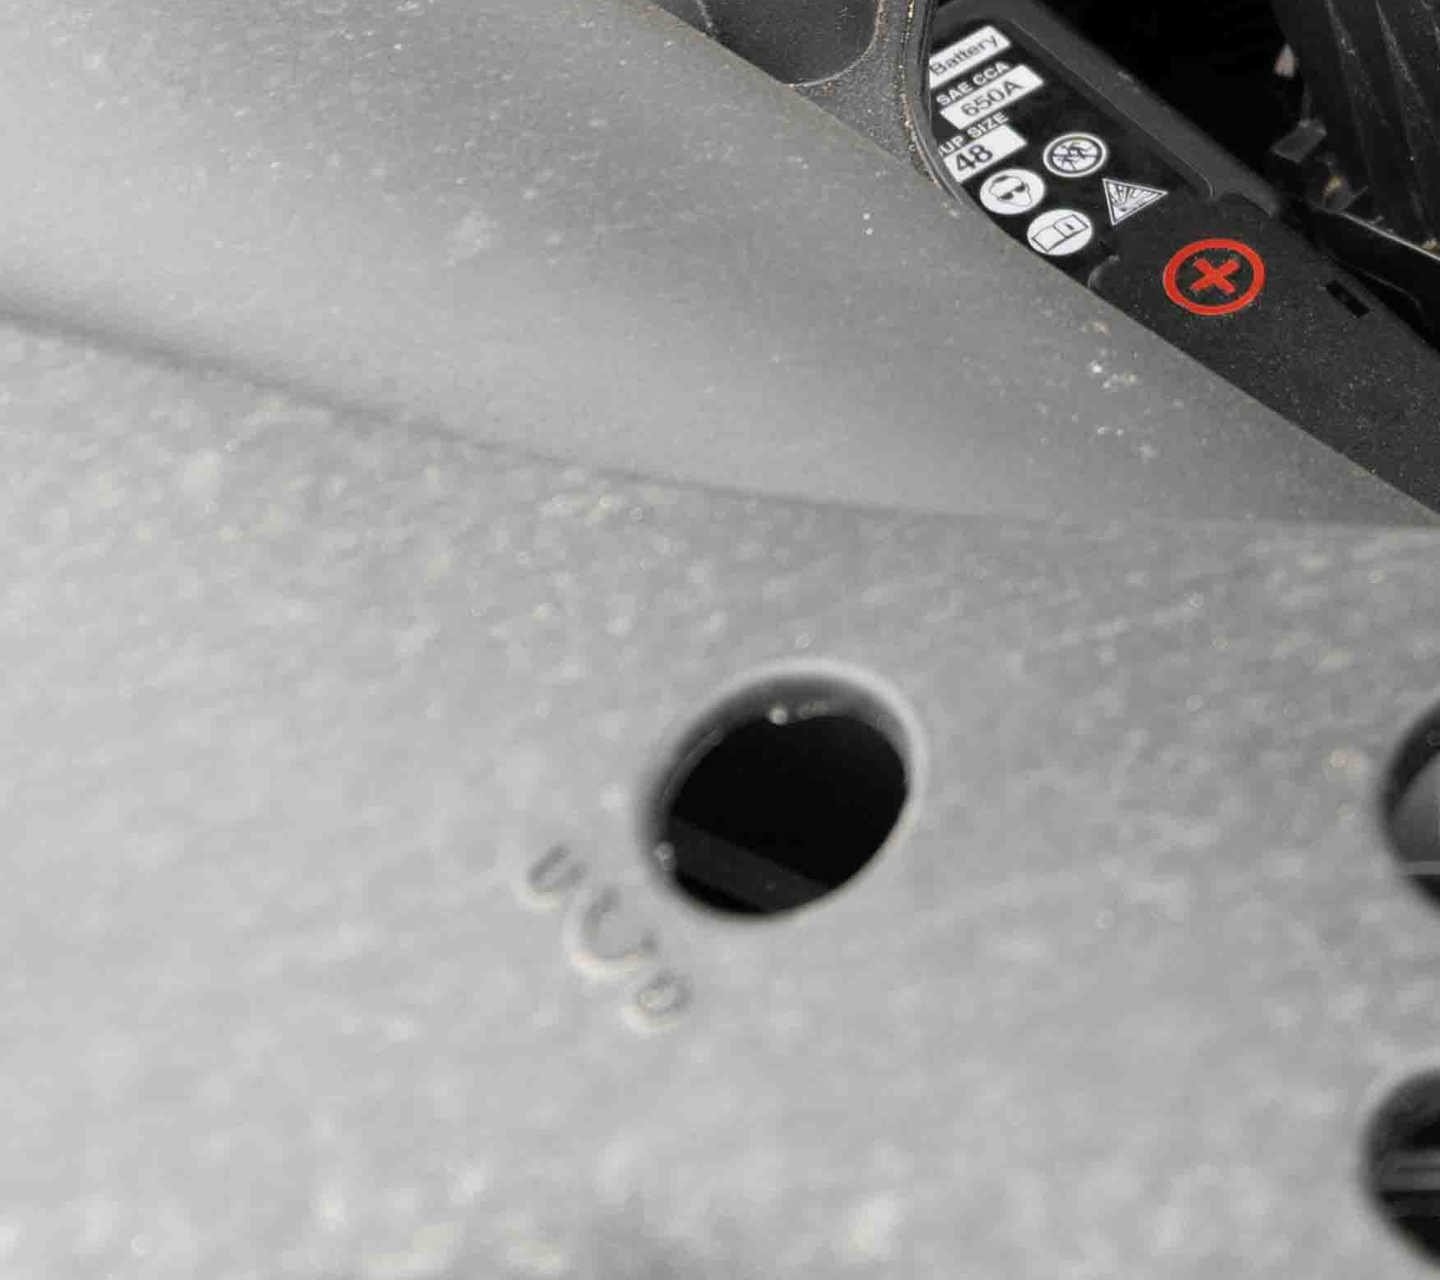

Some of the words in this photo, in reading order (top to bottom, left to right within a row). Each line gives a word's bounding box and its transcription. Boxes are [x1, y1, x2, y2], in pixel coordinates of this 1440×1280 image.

[929, 34, 999, 76] Battery
[936, 81, 974, 106] SAE
[972, 61, 1010, 86] CCA
[960, 80, 1025, 117] 650A
[938, 135, 965, 157] UP
[966, 111, 1009, 139] SIZE
[955, 143, 994, 171] 48
